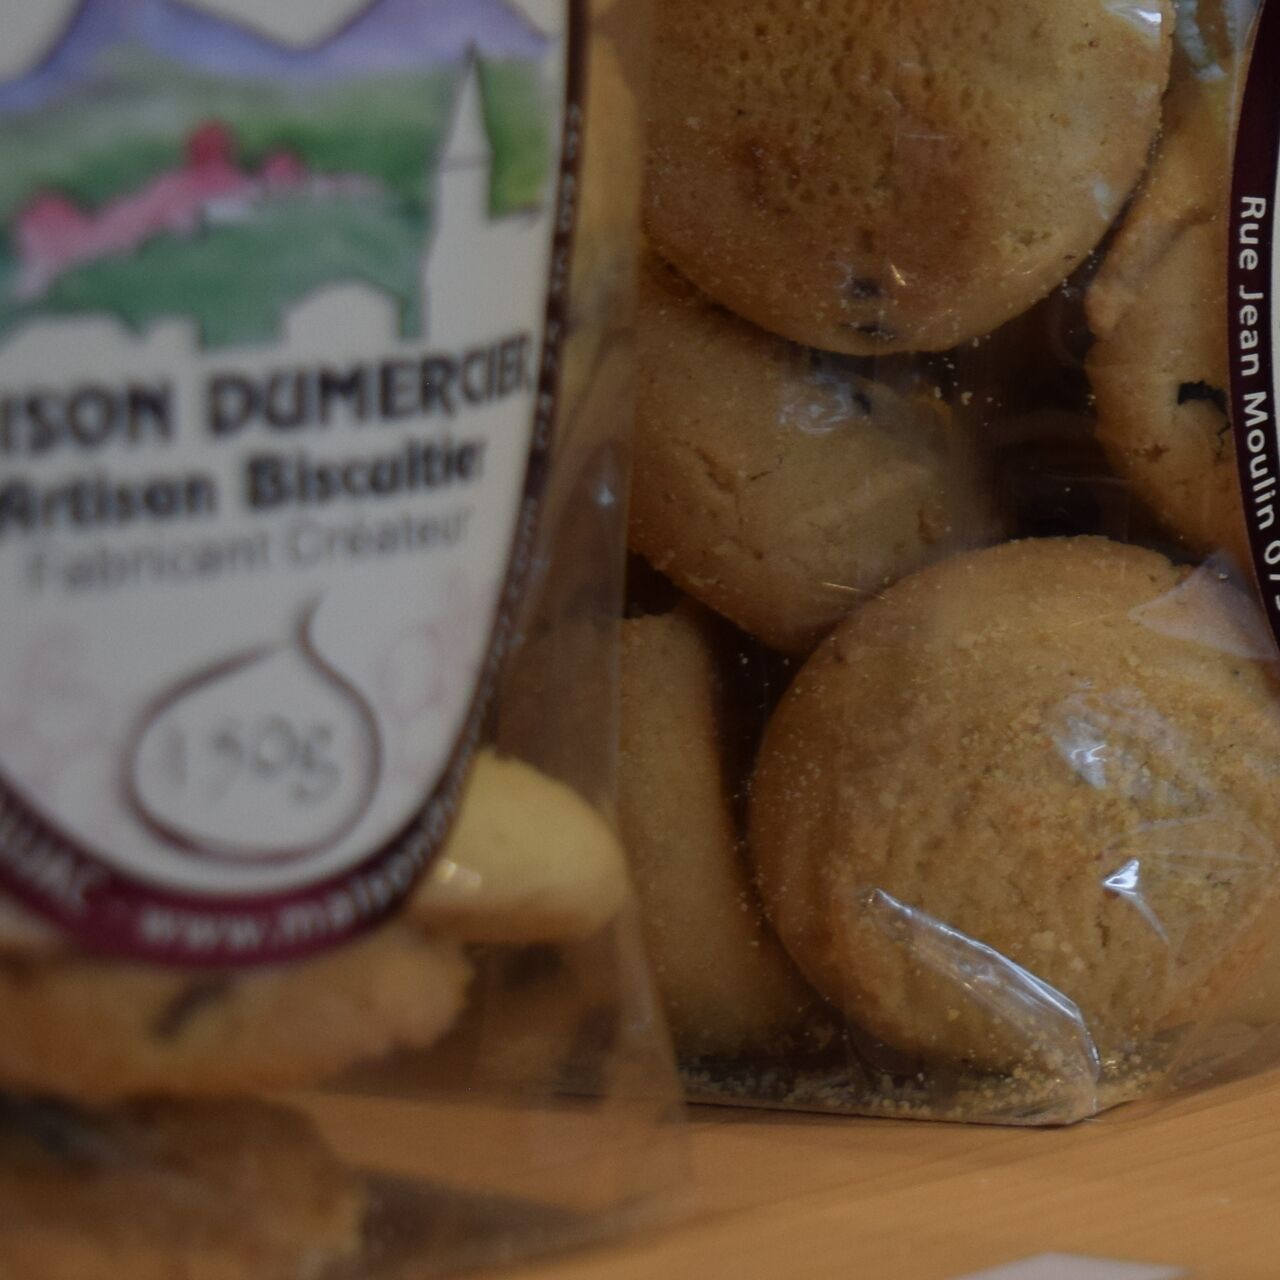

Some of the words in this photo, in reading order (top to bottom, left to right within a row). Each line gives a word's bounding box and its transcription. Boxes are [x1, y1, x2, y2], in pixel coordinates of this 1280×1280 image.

[1239, 195, 1267, 271] Rue
[1239, 283, 1265, 377] Jean
[1242, 390, 1278, 531] Moulin
